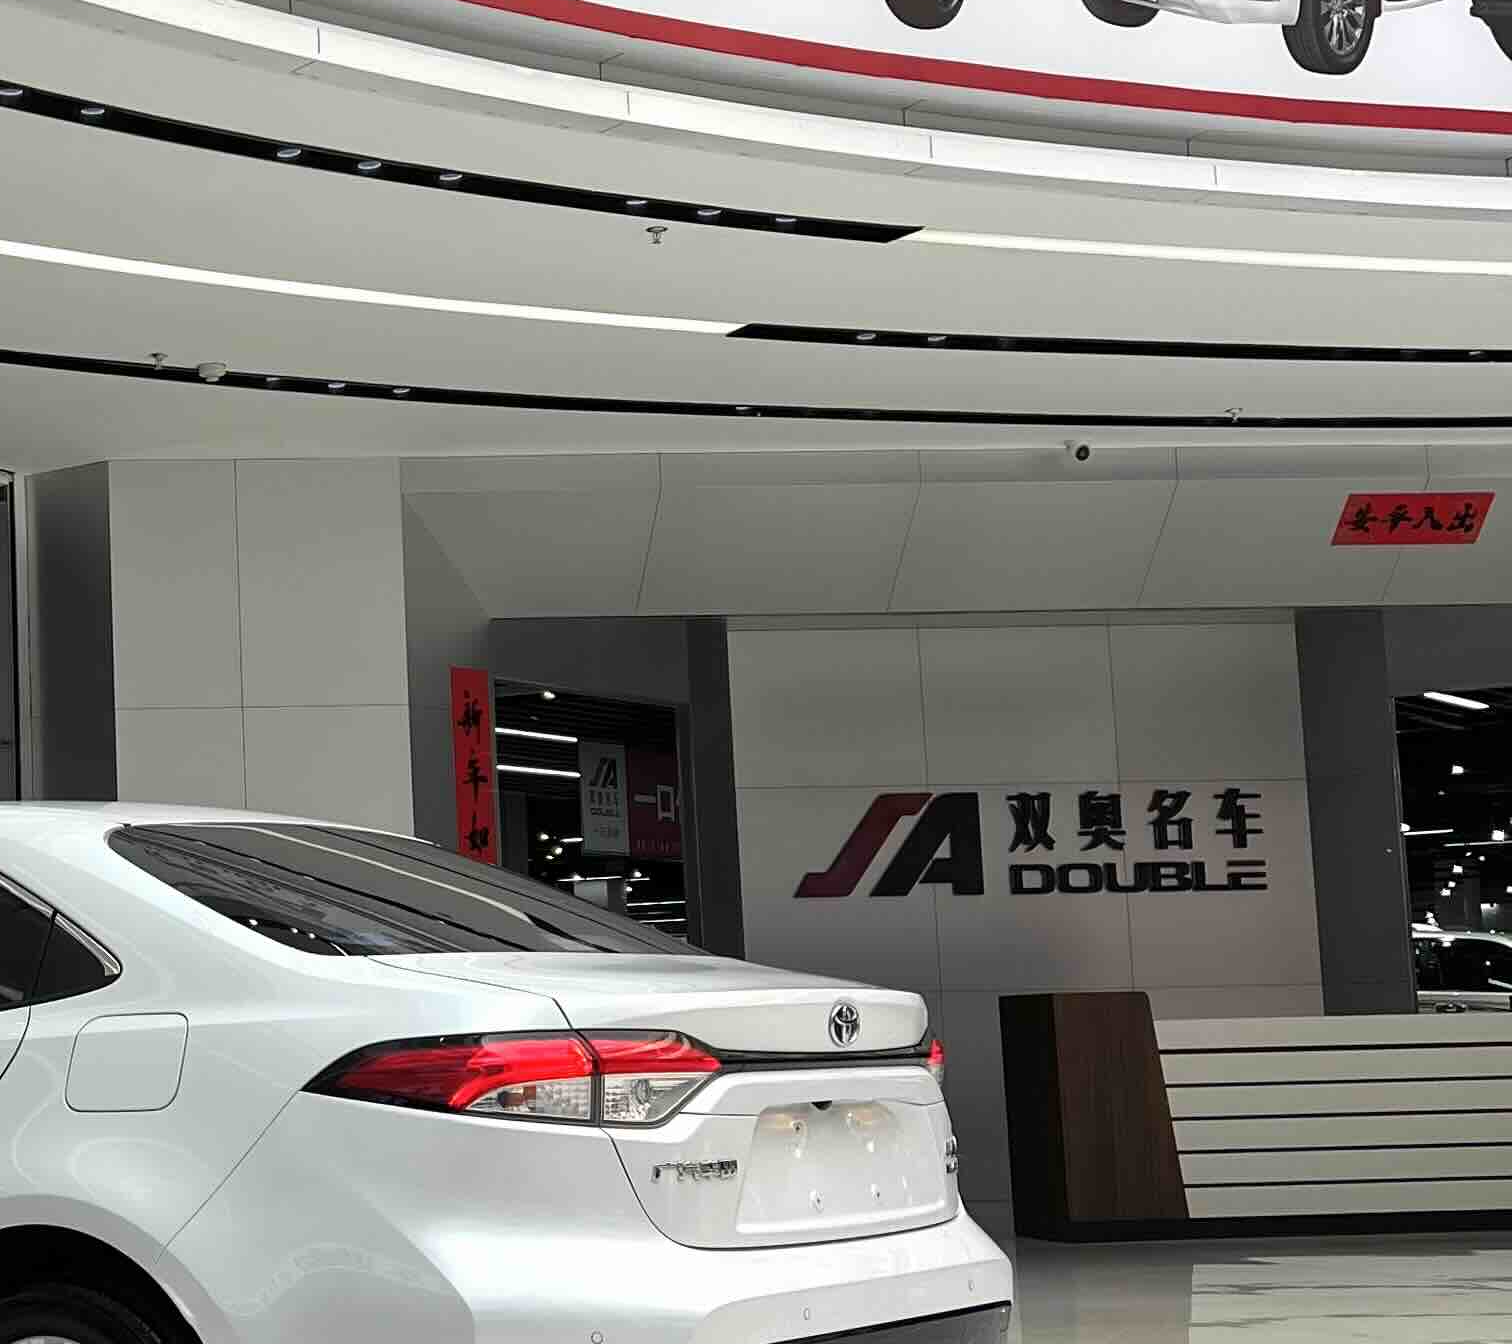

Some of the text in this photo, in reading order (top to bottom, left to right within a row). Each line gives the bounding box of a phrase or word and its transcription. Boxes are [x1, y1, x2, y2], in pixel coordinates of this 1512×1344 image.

[632, 783, 680, 825] 一口
[1005, 788, 1265, 853] 双奥名车
[1008, 859, 1269, 896] DOUBLE
